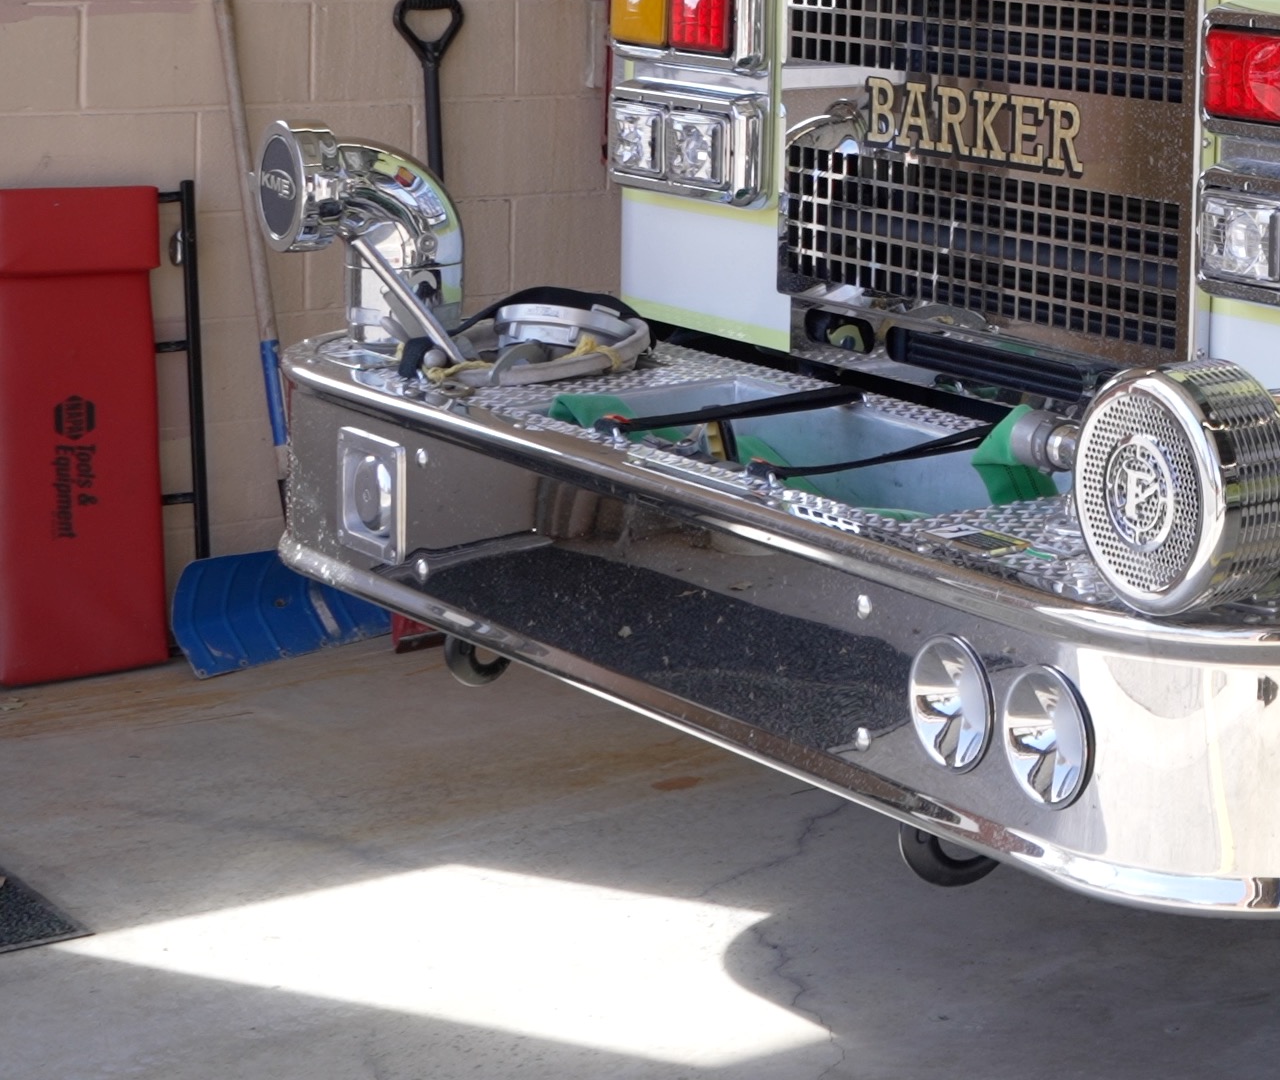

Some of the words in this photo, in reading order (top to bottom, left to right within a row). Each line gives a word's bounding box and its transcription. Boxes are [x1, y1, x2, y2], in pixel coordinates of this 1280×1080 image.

[865, 76, 1084, 176] BARKER
[261, 171, 290, 195] KME
[63, 401, 87, 435] NAPA
[76, 445, 97, 489] Tools
[52, 444, 77, 539] Equipment
[78, 493, 99, 506] &
